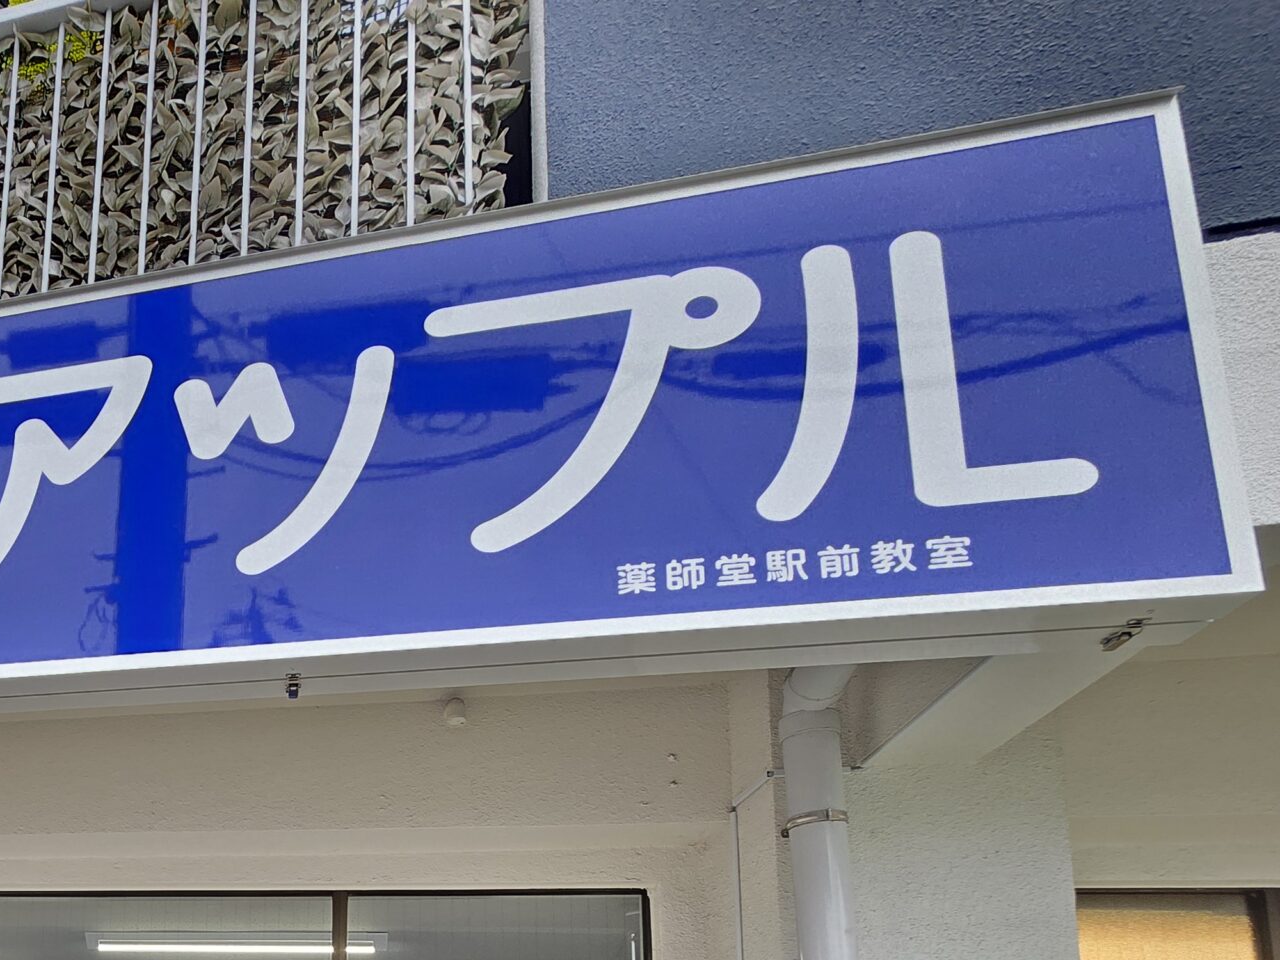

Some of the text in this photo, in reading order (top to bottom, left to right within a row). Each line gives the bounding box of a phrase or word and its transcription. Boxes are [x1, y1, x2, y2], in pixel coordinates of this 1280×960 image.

[617, 535, 973, 595] 薬師堂駅前教室
